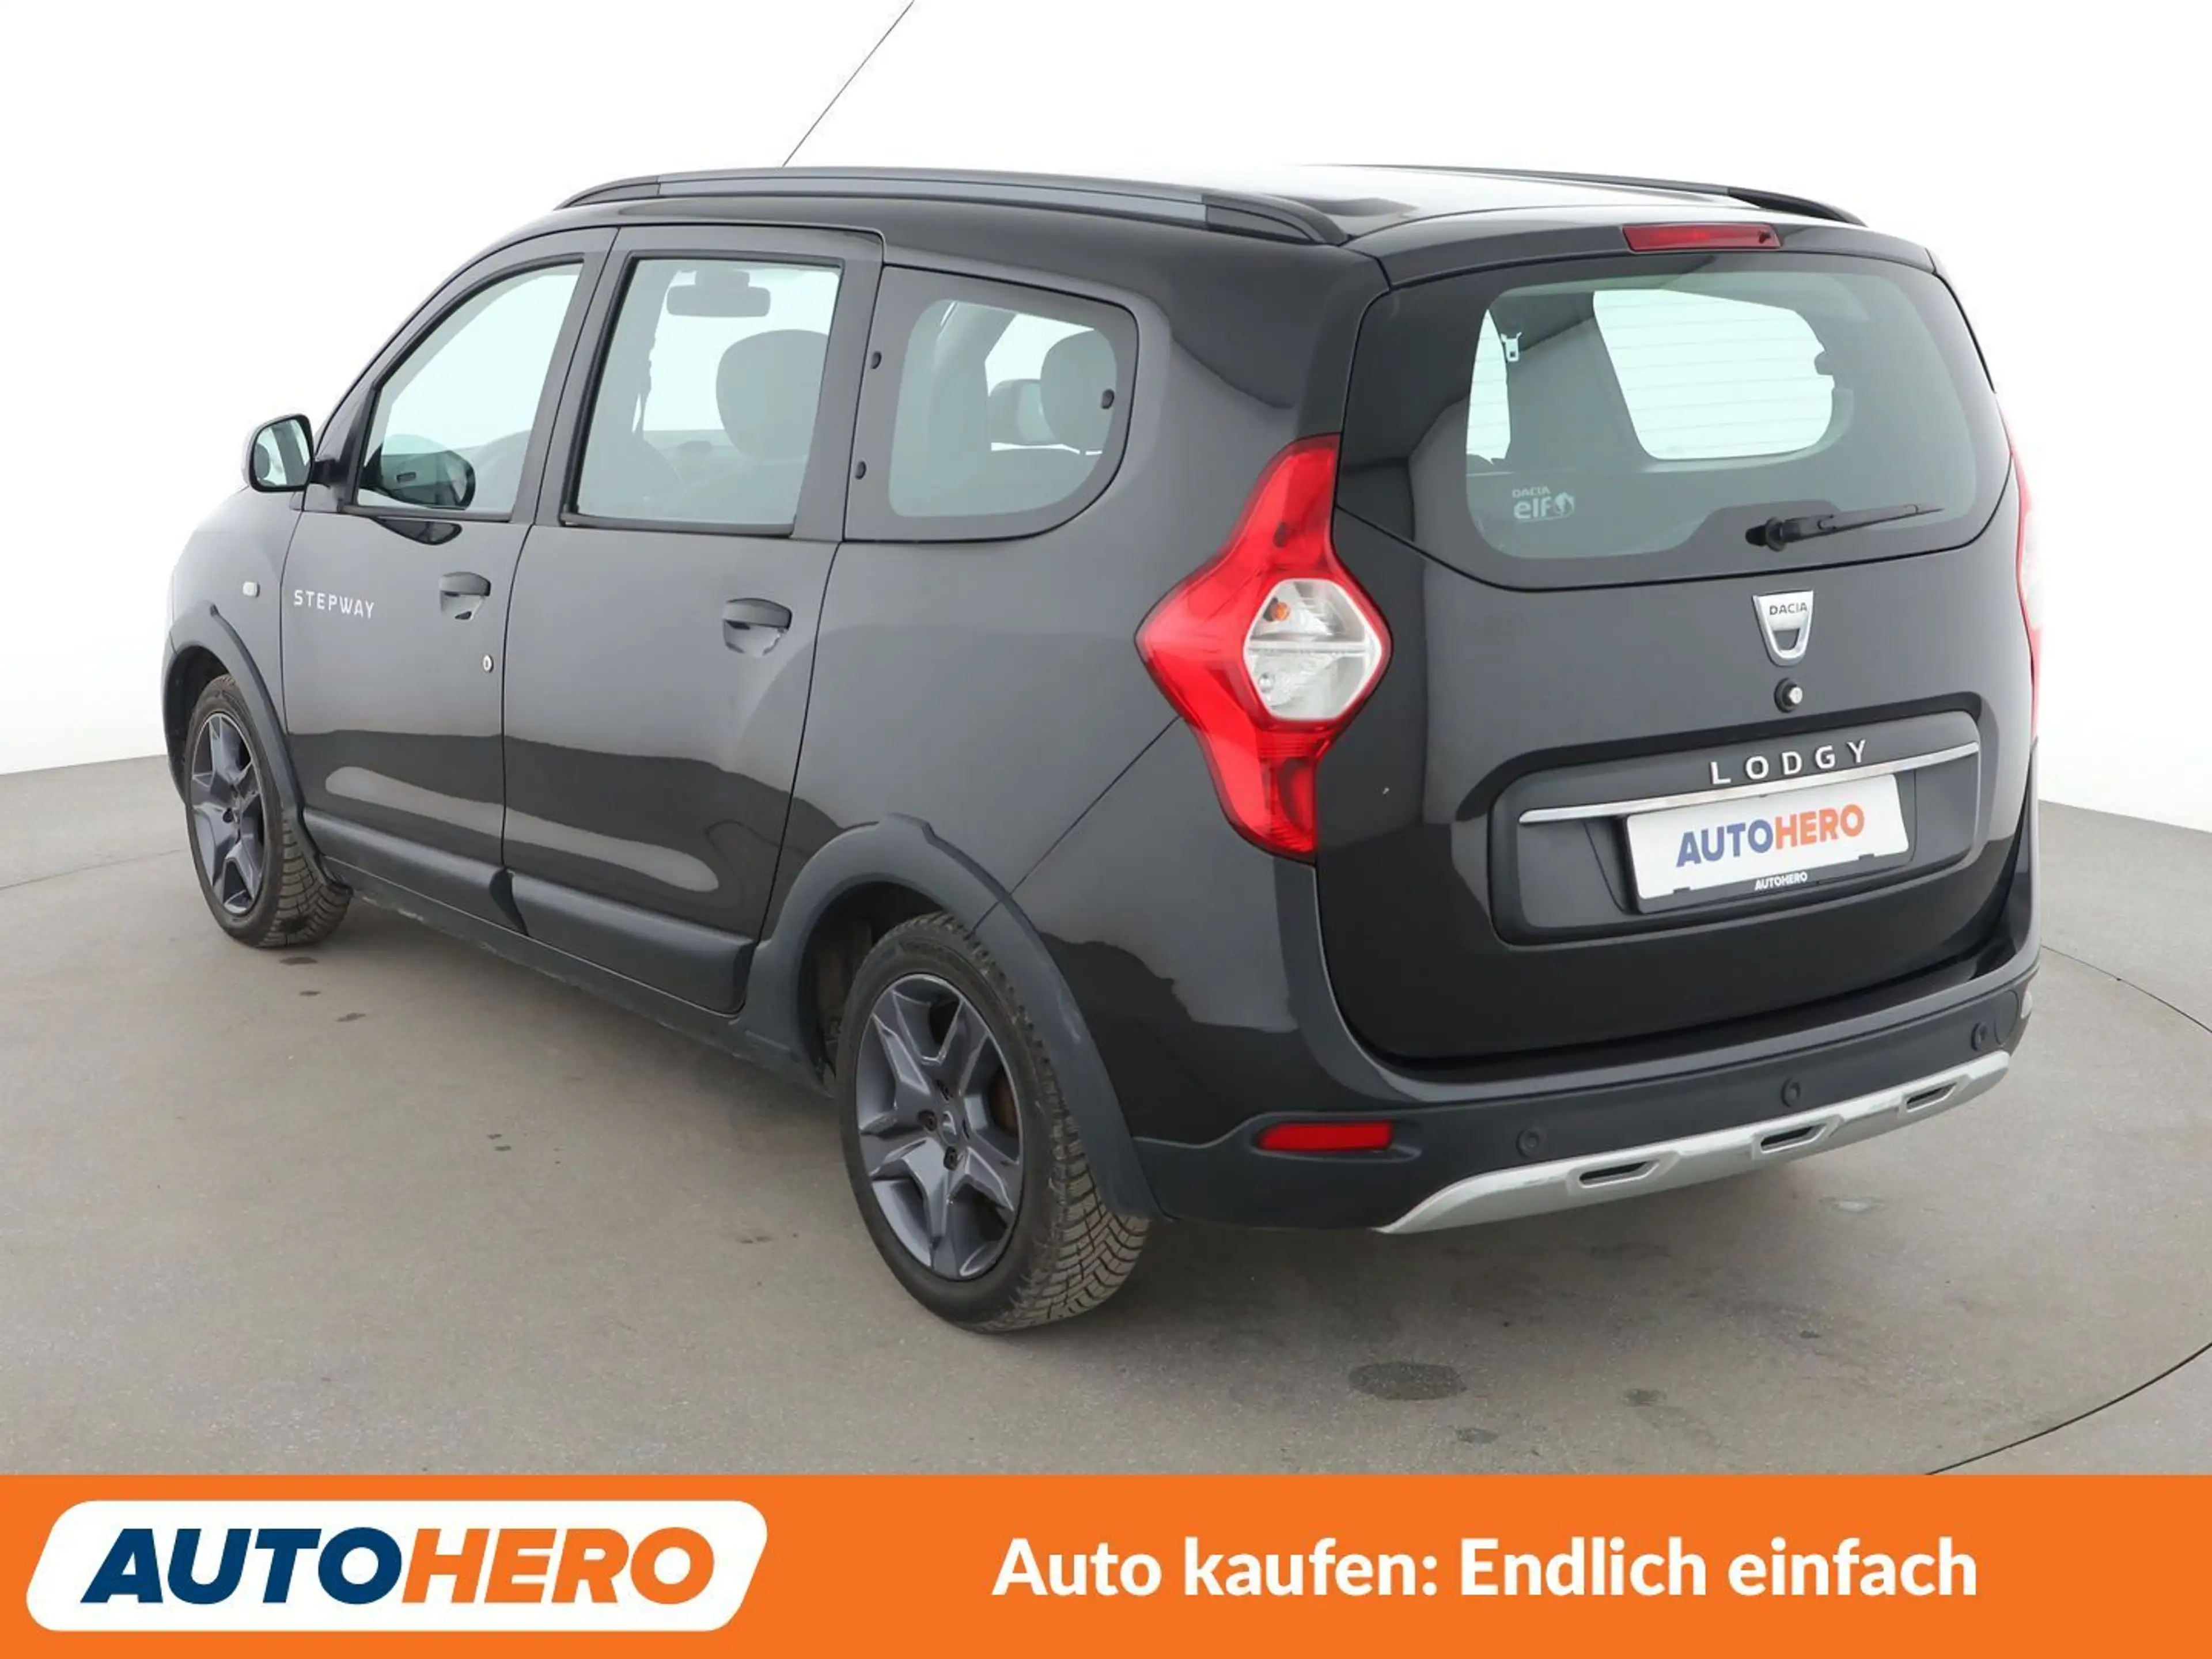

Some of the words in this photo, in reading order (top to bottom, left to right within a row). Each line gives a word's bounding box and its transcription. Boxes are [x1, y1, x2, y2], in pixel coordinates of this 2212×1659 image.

[1513, 496, 1551, 519] elf
[293, 589, 374, 618] STEPWAY
[1769, 603, 1808, 615] DACIA
[1710, 740, 1866, 785] LODGY
[1676, 804, 1865, 867] AUTOHERO
[1754, 871, 1808, 891] AUTOHERO
